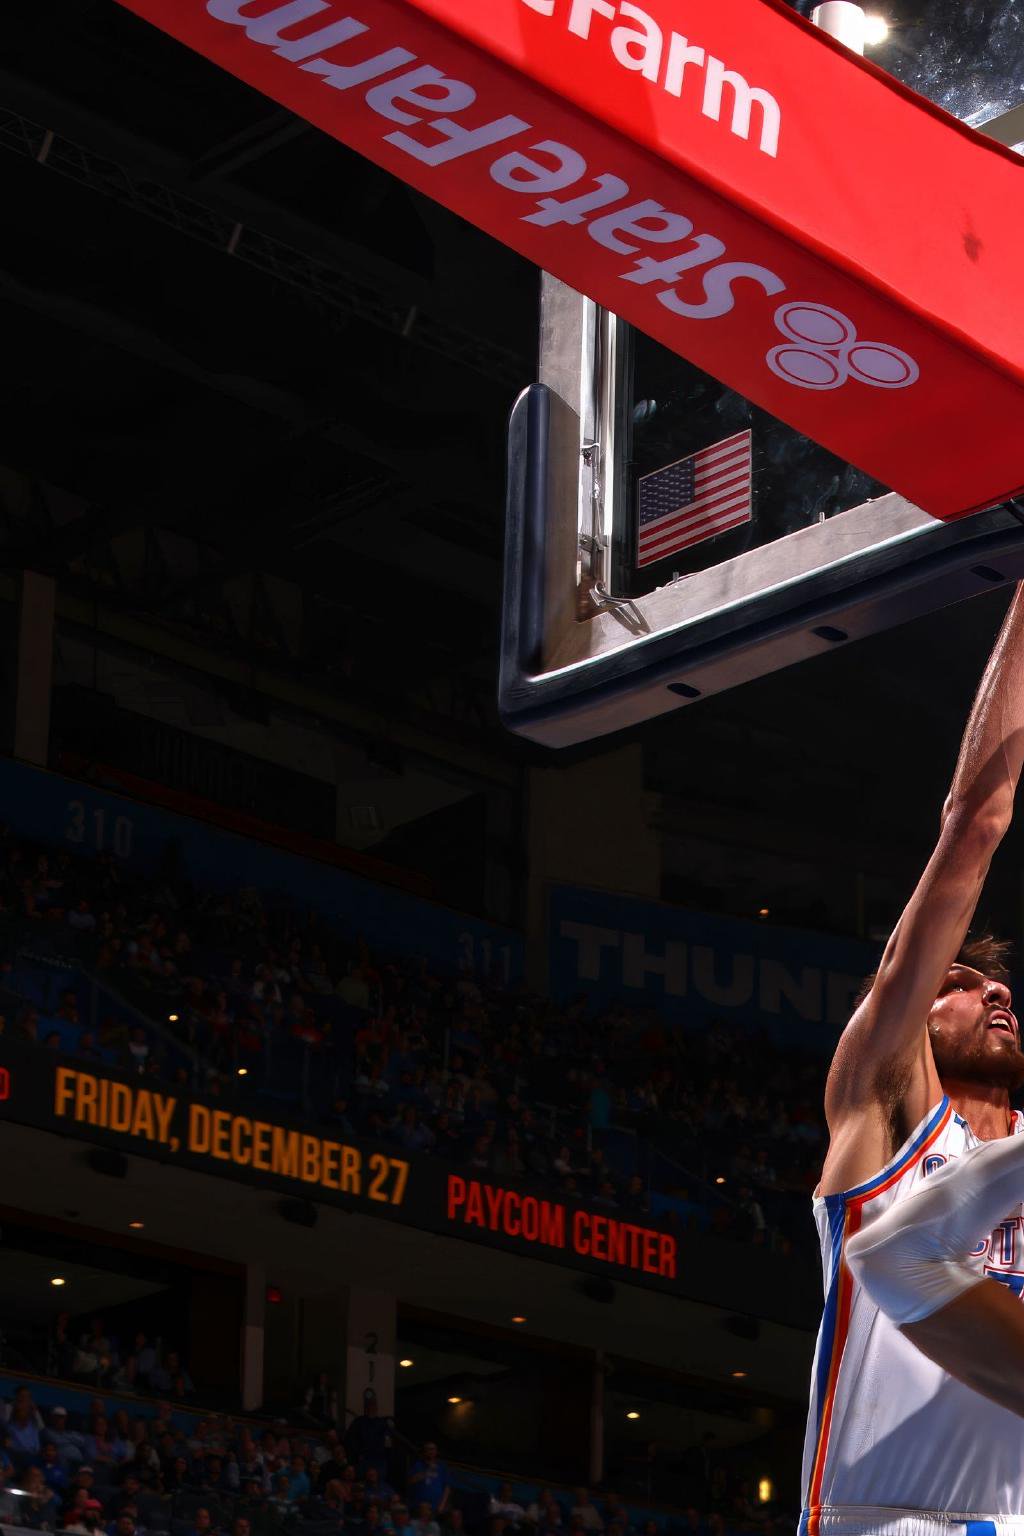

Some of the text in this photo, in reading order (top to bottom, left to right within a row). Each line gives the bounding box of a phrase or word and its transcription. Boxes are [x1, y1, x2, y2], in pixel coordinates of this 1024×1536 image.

[64, 799, 134, 859] 310
[456, 931, 512, 985] 311
[53, 1066, 181, 1153] FRIDAY,
[187, 1103, 363, 1196] DECEMBER
[366, 1154, 411, 1207] 27
[447, 1172, 677, 1280] PAYCOM CENTER
